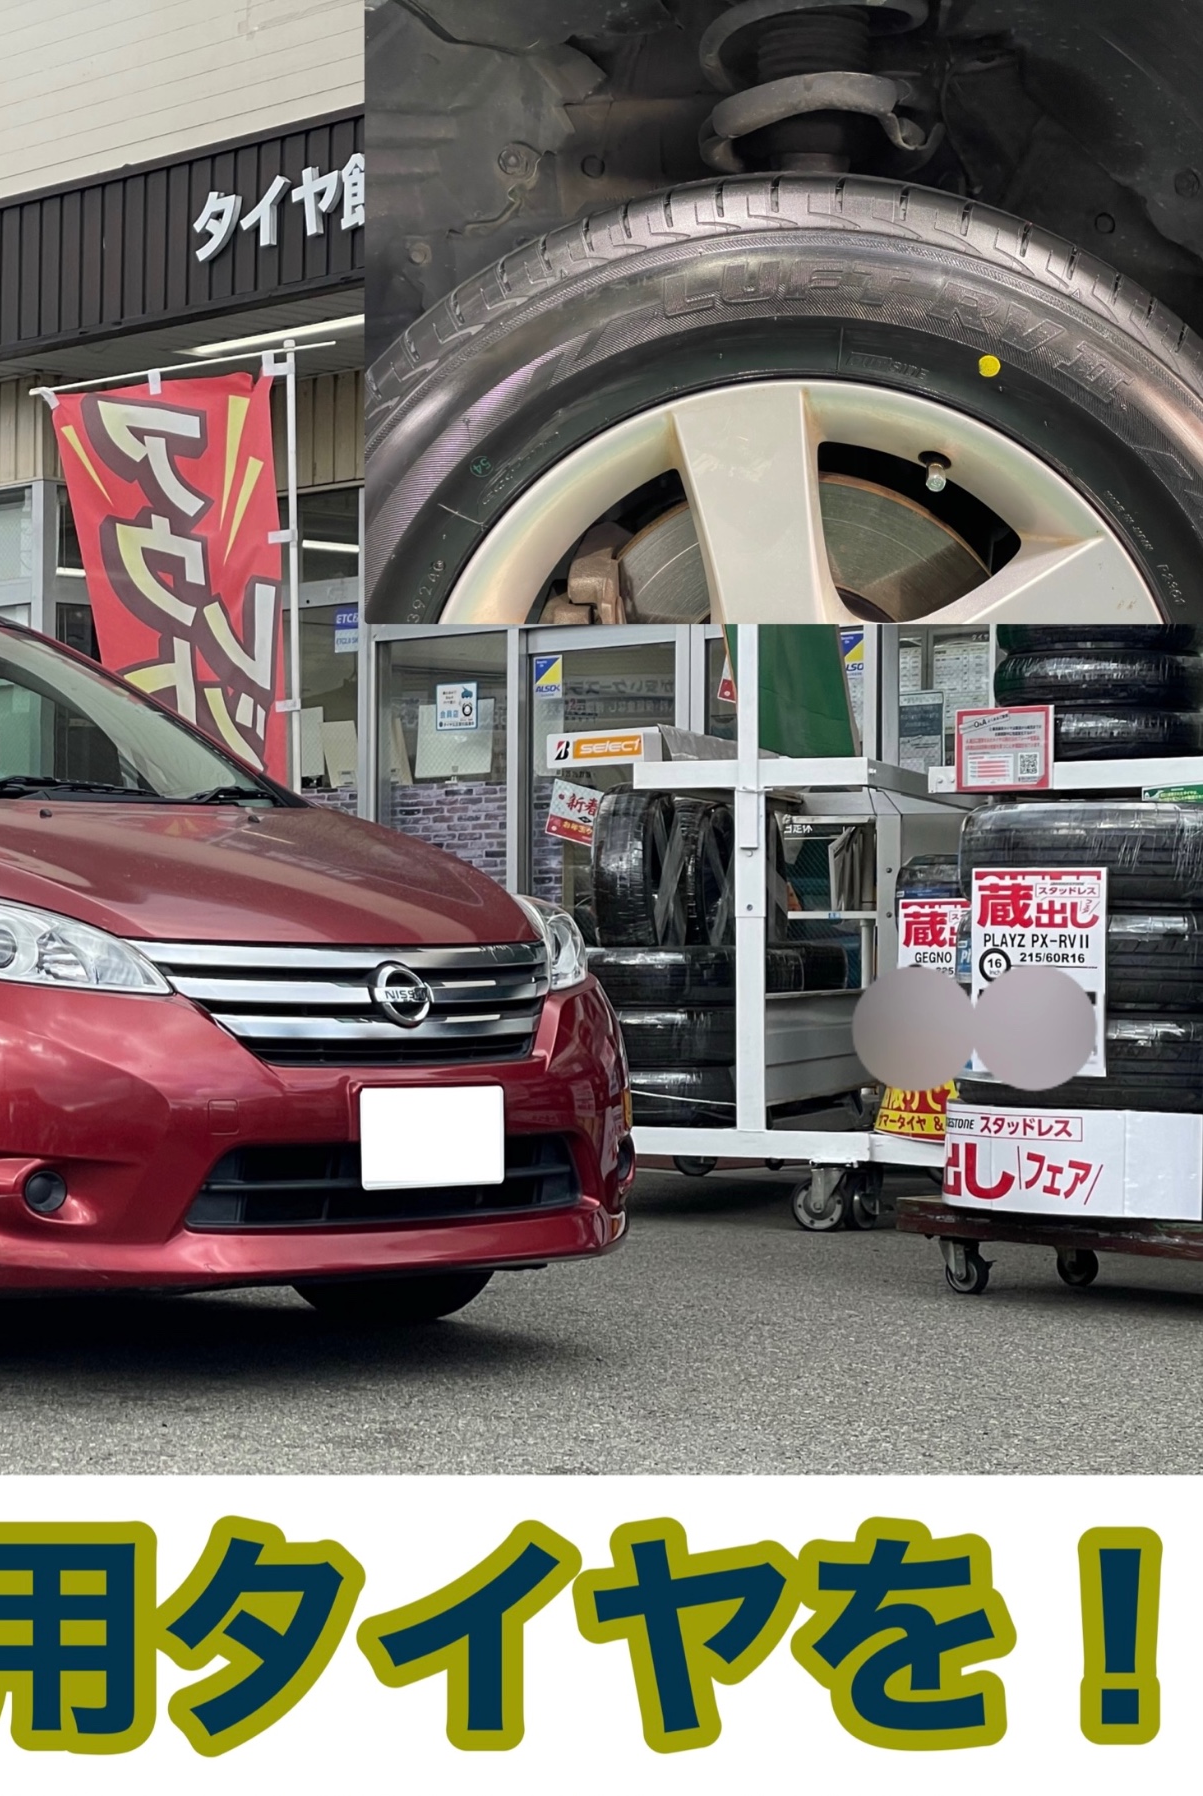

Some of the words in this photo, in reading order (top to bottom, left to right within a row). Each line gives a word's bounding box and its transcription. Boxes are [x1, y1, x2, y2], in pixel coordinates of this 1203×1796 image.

[662, 260, 911, 319] LUFT
[846, 662, 864, 672] LSO
[580, 738, 642, 754] select
[1038, 886, 1097, 895] スタッドレス
[977, 883, 1100, 929] 蔵出し
[983, 933, 1026, 948] PLAYZ
[914, 951, 953, 964] GEGNO
[987, 958, 1003, 969] 16
[1019, 952, 1086, 964] 215/60R16
[980, 1115, 1074, 1138] スタッドレス
[1025, 1151, 1094, 1199] フェア
